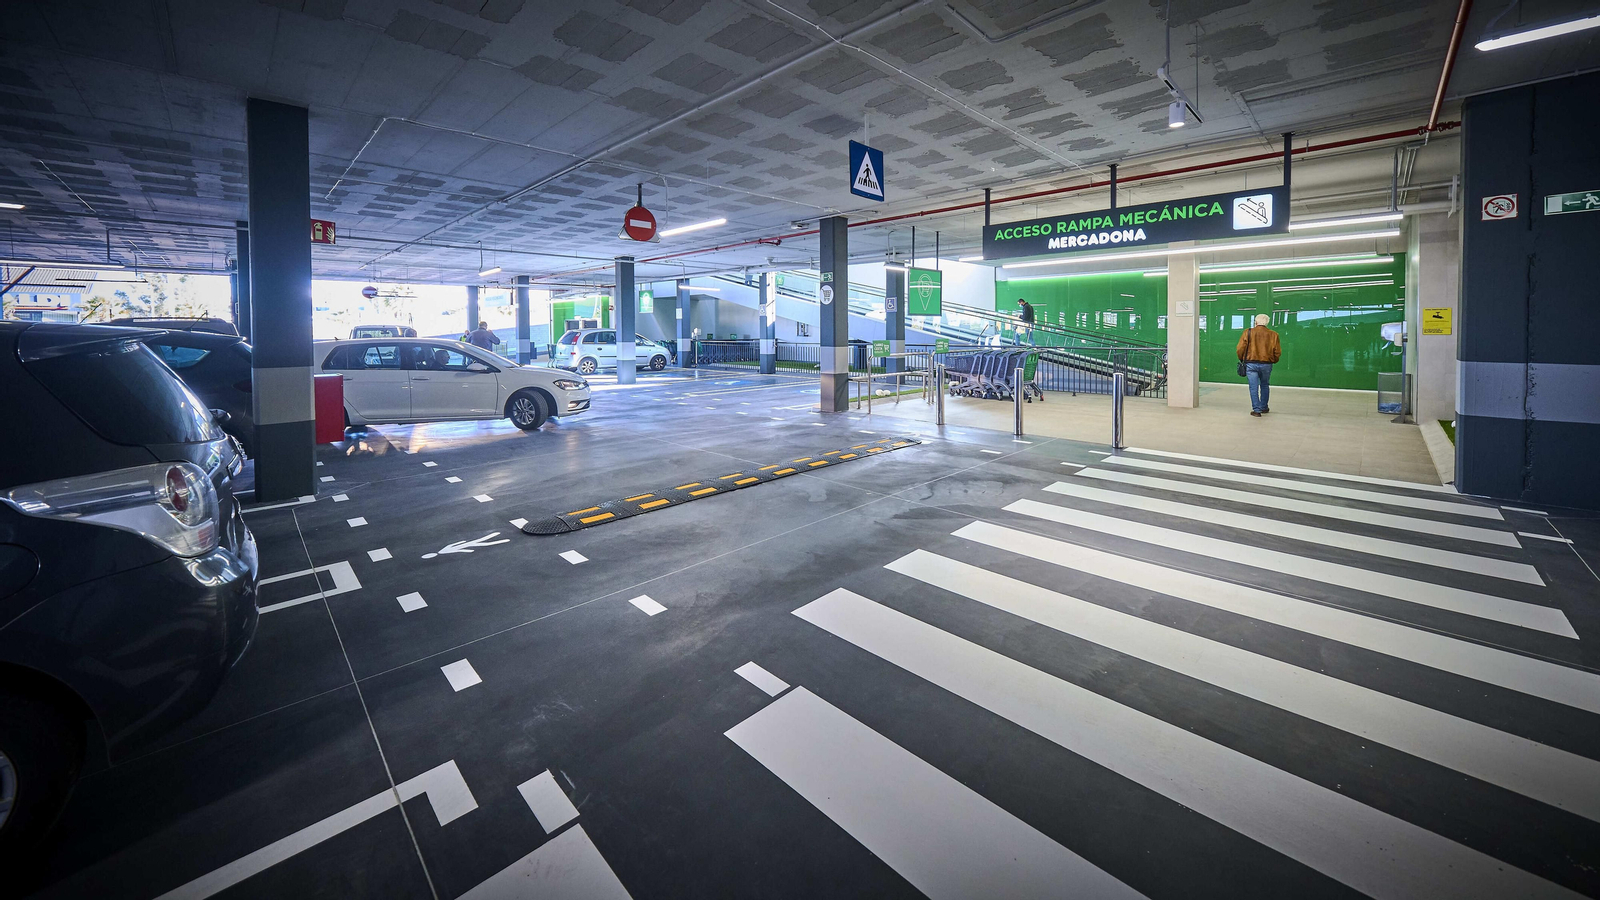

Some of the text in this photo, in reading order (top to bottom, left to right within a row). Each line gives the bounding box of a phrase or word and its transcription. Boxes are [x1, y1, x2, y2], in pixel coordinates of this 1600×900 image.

[994, 201, 1225, 241] ACCESO RAMPA MECÁNICA
[1047, 228, 1147, 250] MERCADONA
